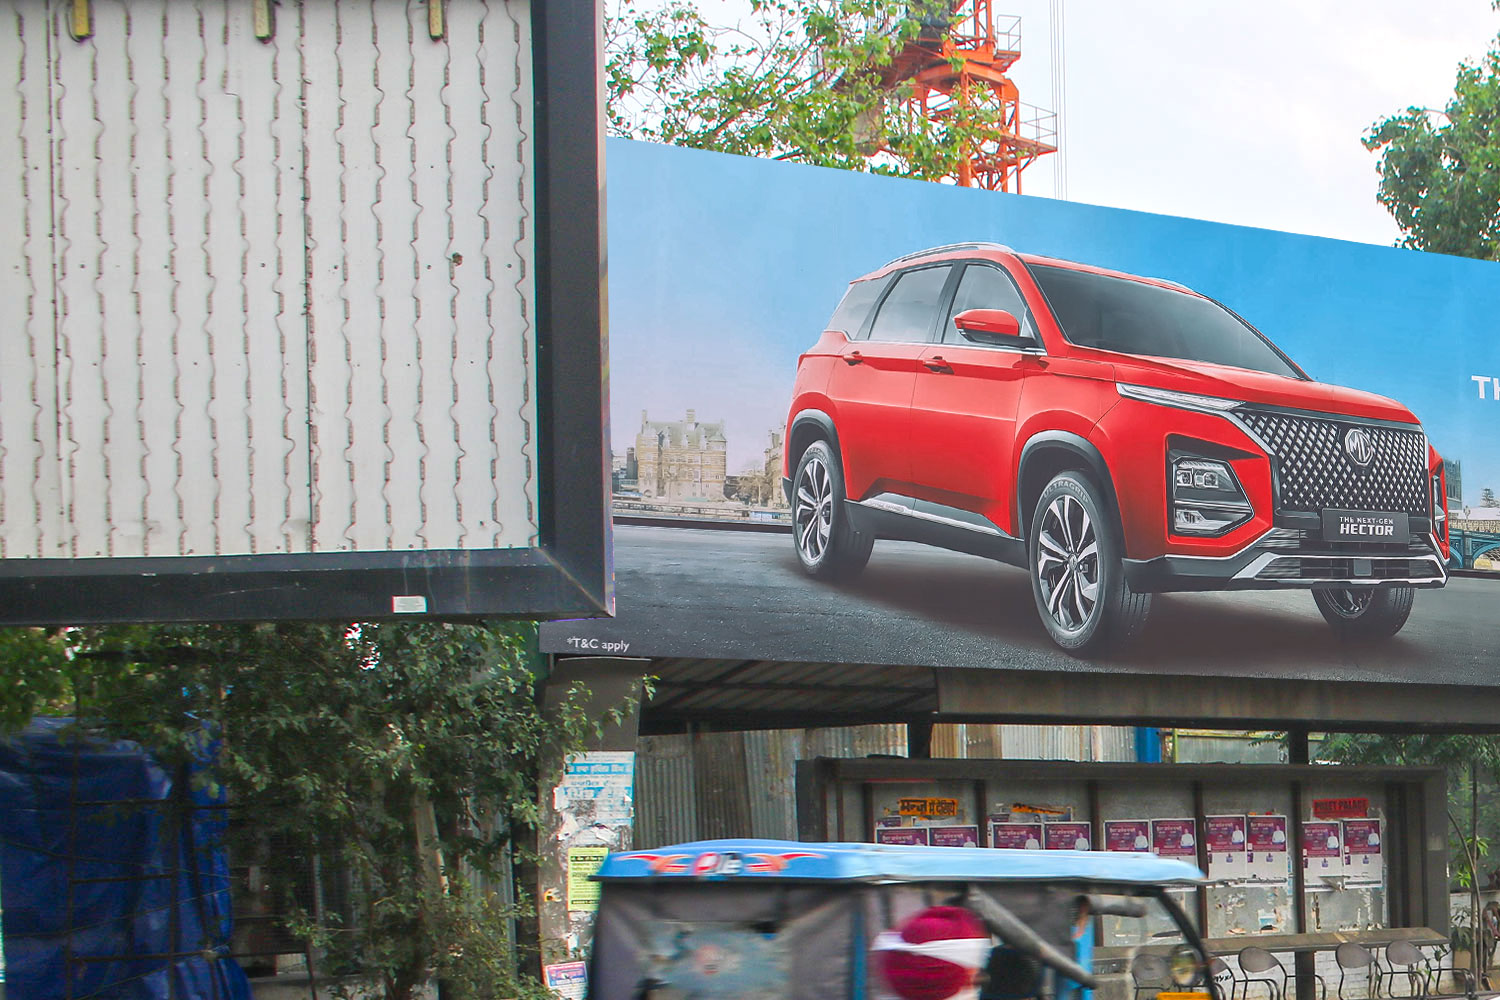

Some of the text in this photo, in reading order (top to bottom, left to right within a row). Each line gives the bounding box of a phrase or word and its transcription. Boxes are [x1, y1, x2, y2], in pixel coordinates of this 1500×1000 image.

[1347, 430, 1372, 464] MG
[1340, 516, 1394, 525] THE NEXT-GEN
[1340, 523, 1394, 536] HECTOR
[601, 640, 631, 653] apply
